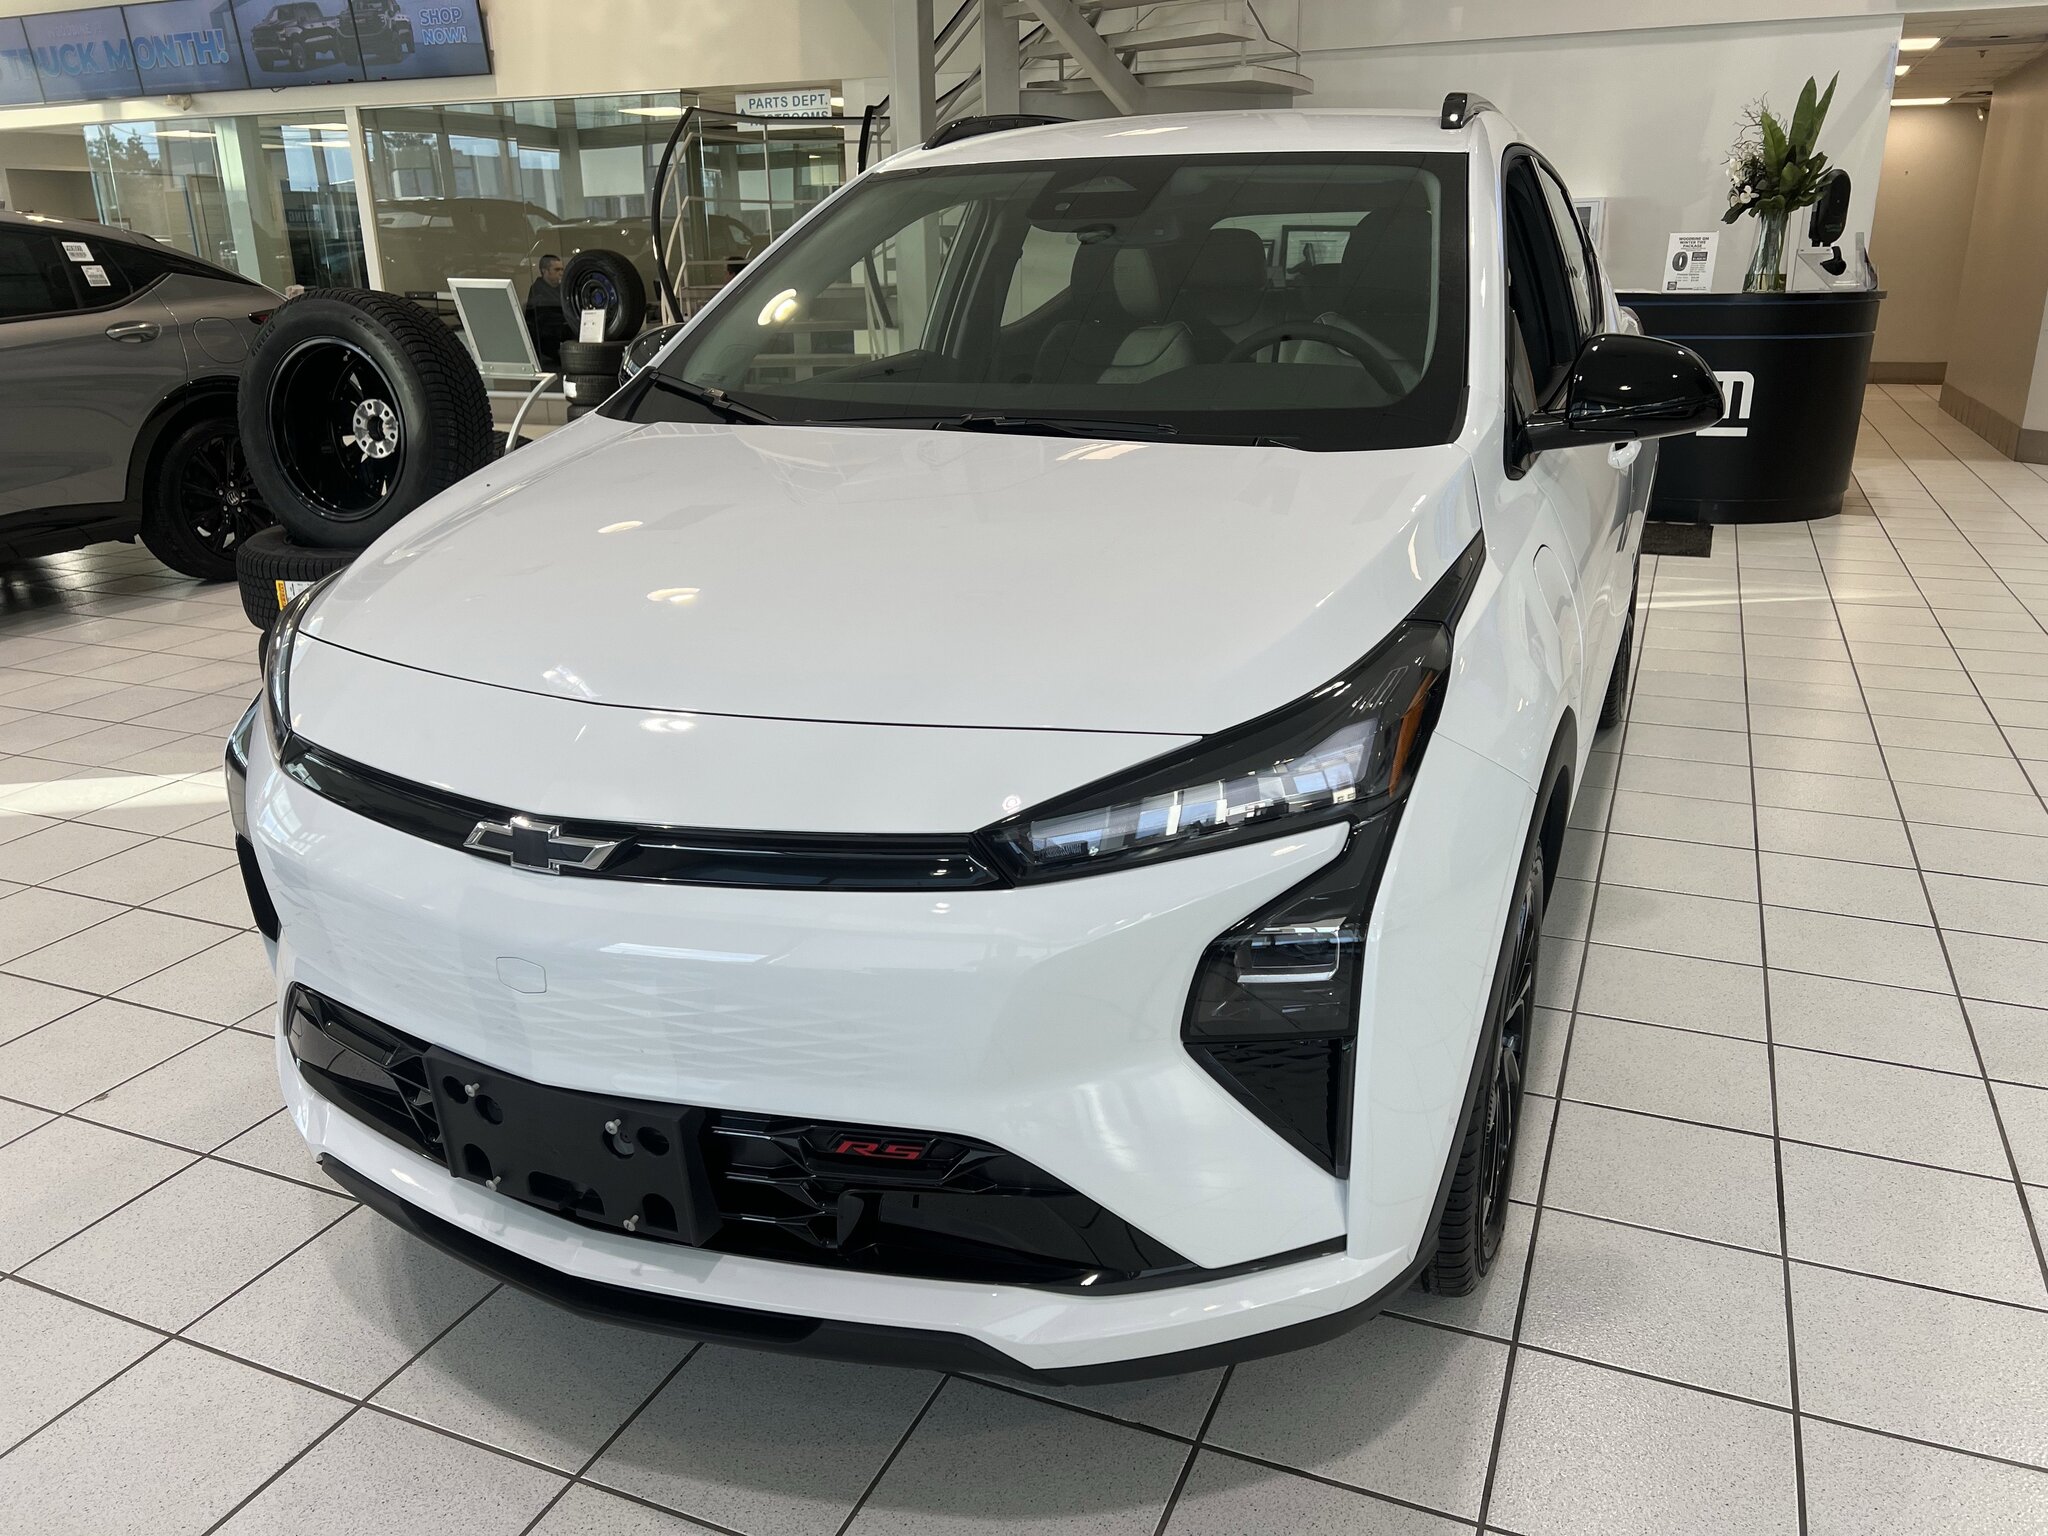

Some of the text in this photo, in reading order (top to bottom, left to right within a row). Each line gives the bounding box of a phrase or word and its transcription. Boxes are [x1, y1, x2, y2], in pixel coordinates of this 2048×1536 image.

[419, 7, 463, 26] SHOP
[421, 26, 468, 46] NOW!
[0, 41, 103, 80] TRUCK
[102, 28, 230, 74] MONTH!
[748, 93, 829, 110] PARTS DEPT.
[836, 1140, 923, 1160] RS
